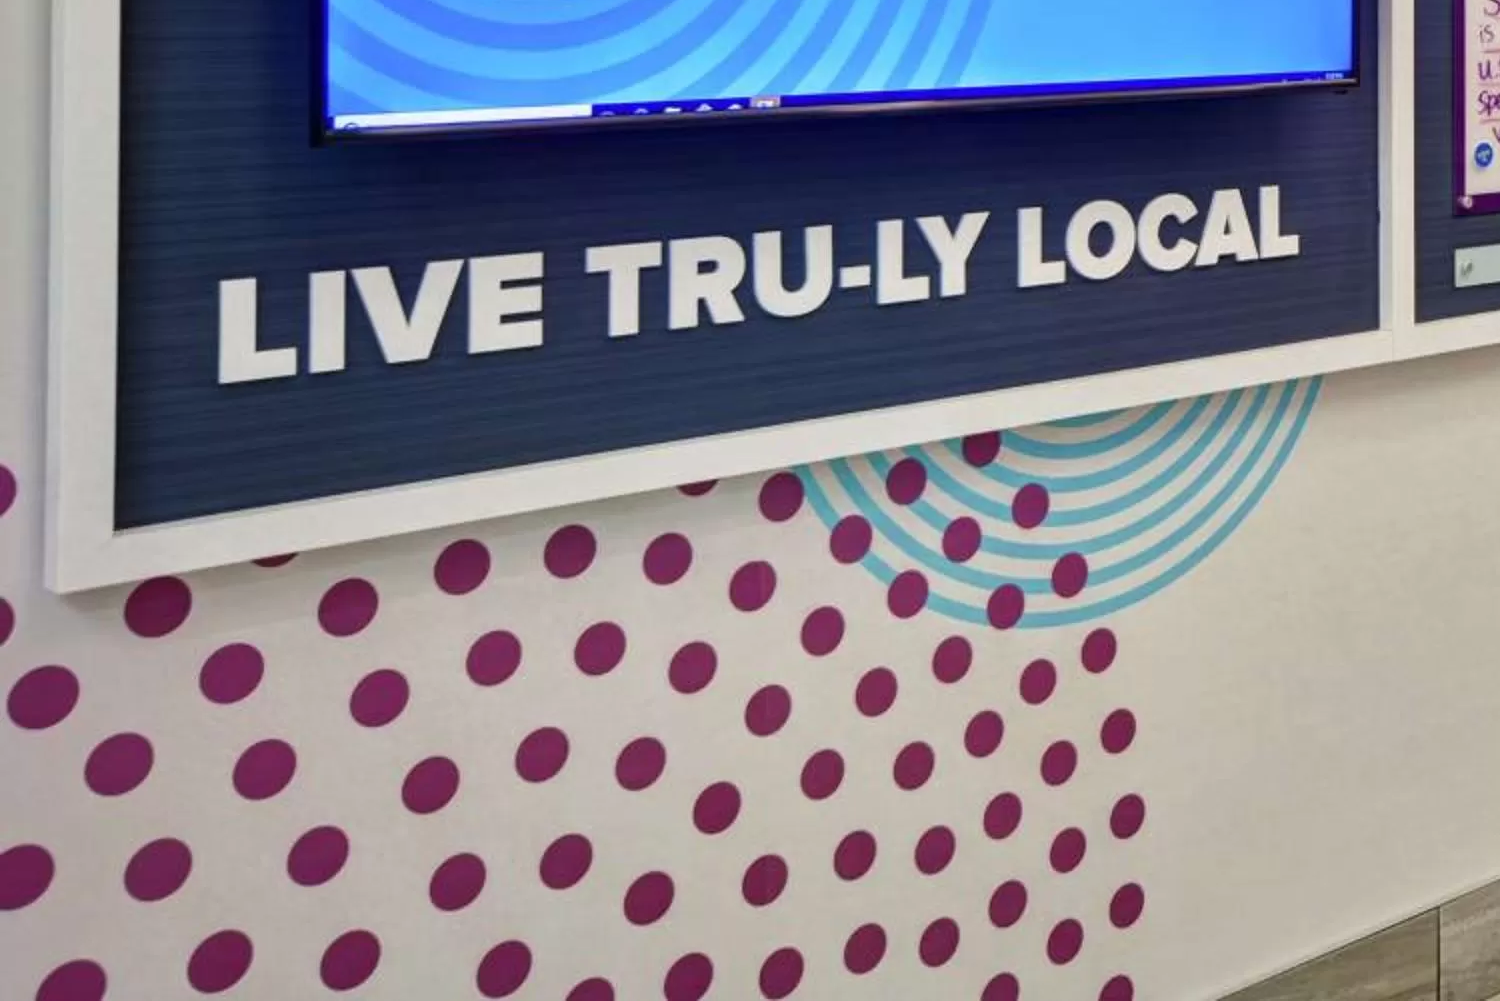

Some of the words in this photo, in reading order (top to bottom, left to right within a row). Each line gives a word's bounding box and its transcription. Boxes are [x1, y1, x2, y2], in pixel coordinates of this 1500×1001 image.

[1479, 23, 1495, 44] is
[217, 250, 545, 385] LIVE
[585, 210, 990, 338] TRU-LY
[1016, 184, 1300, 290] LOCAL
